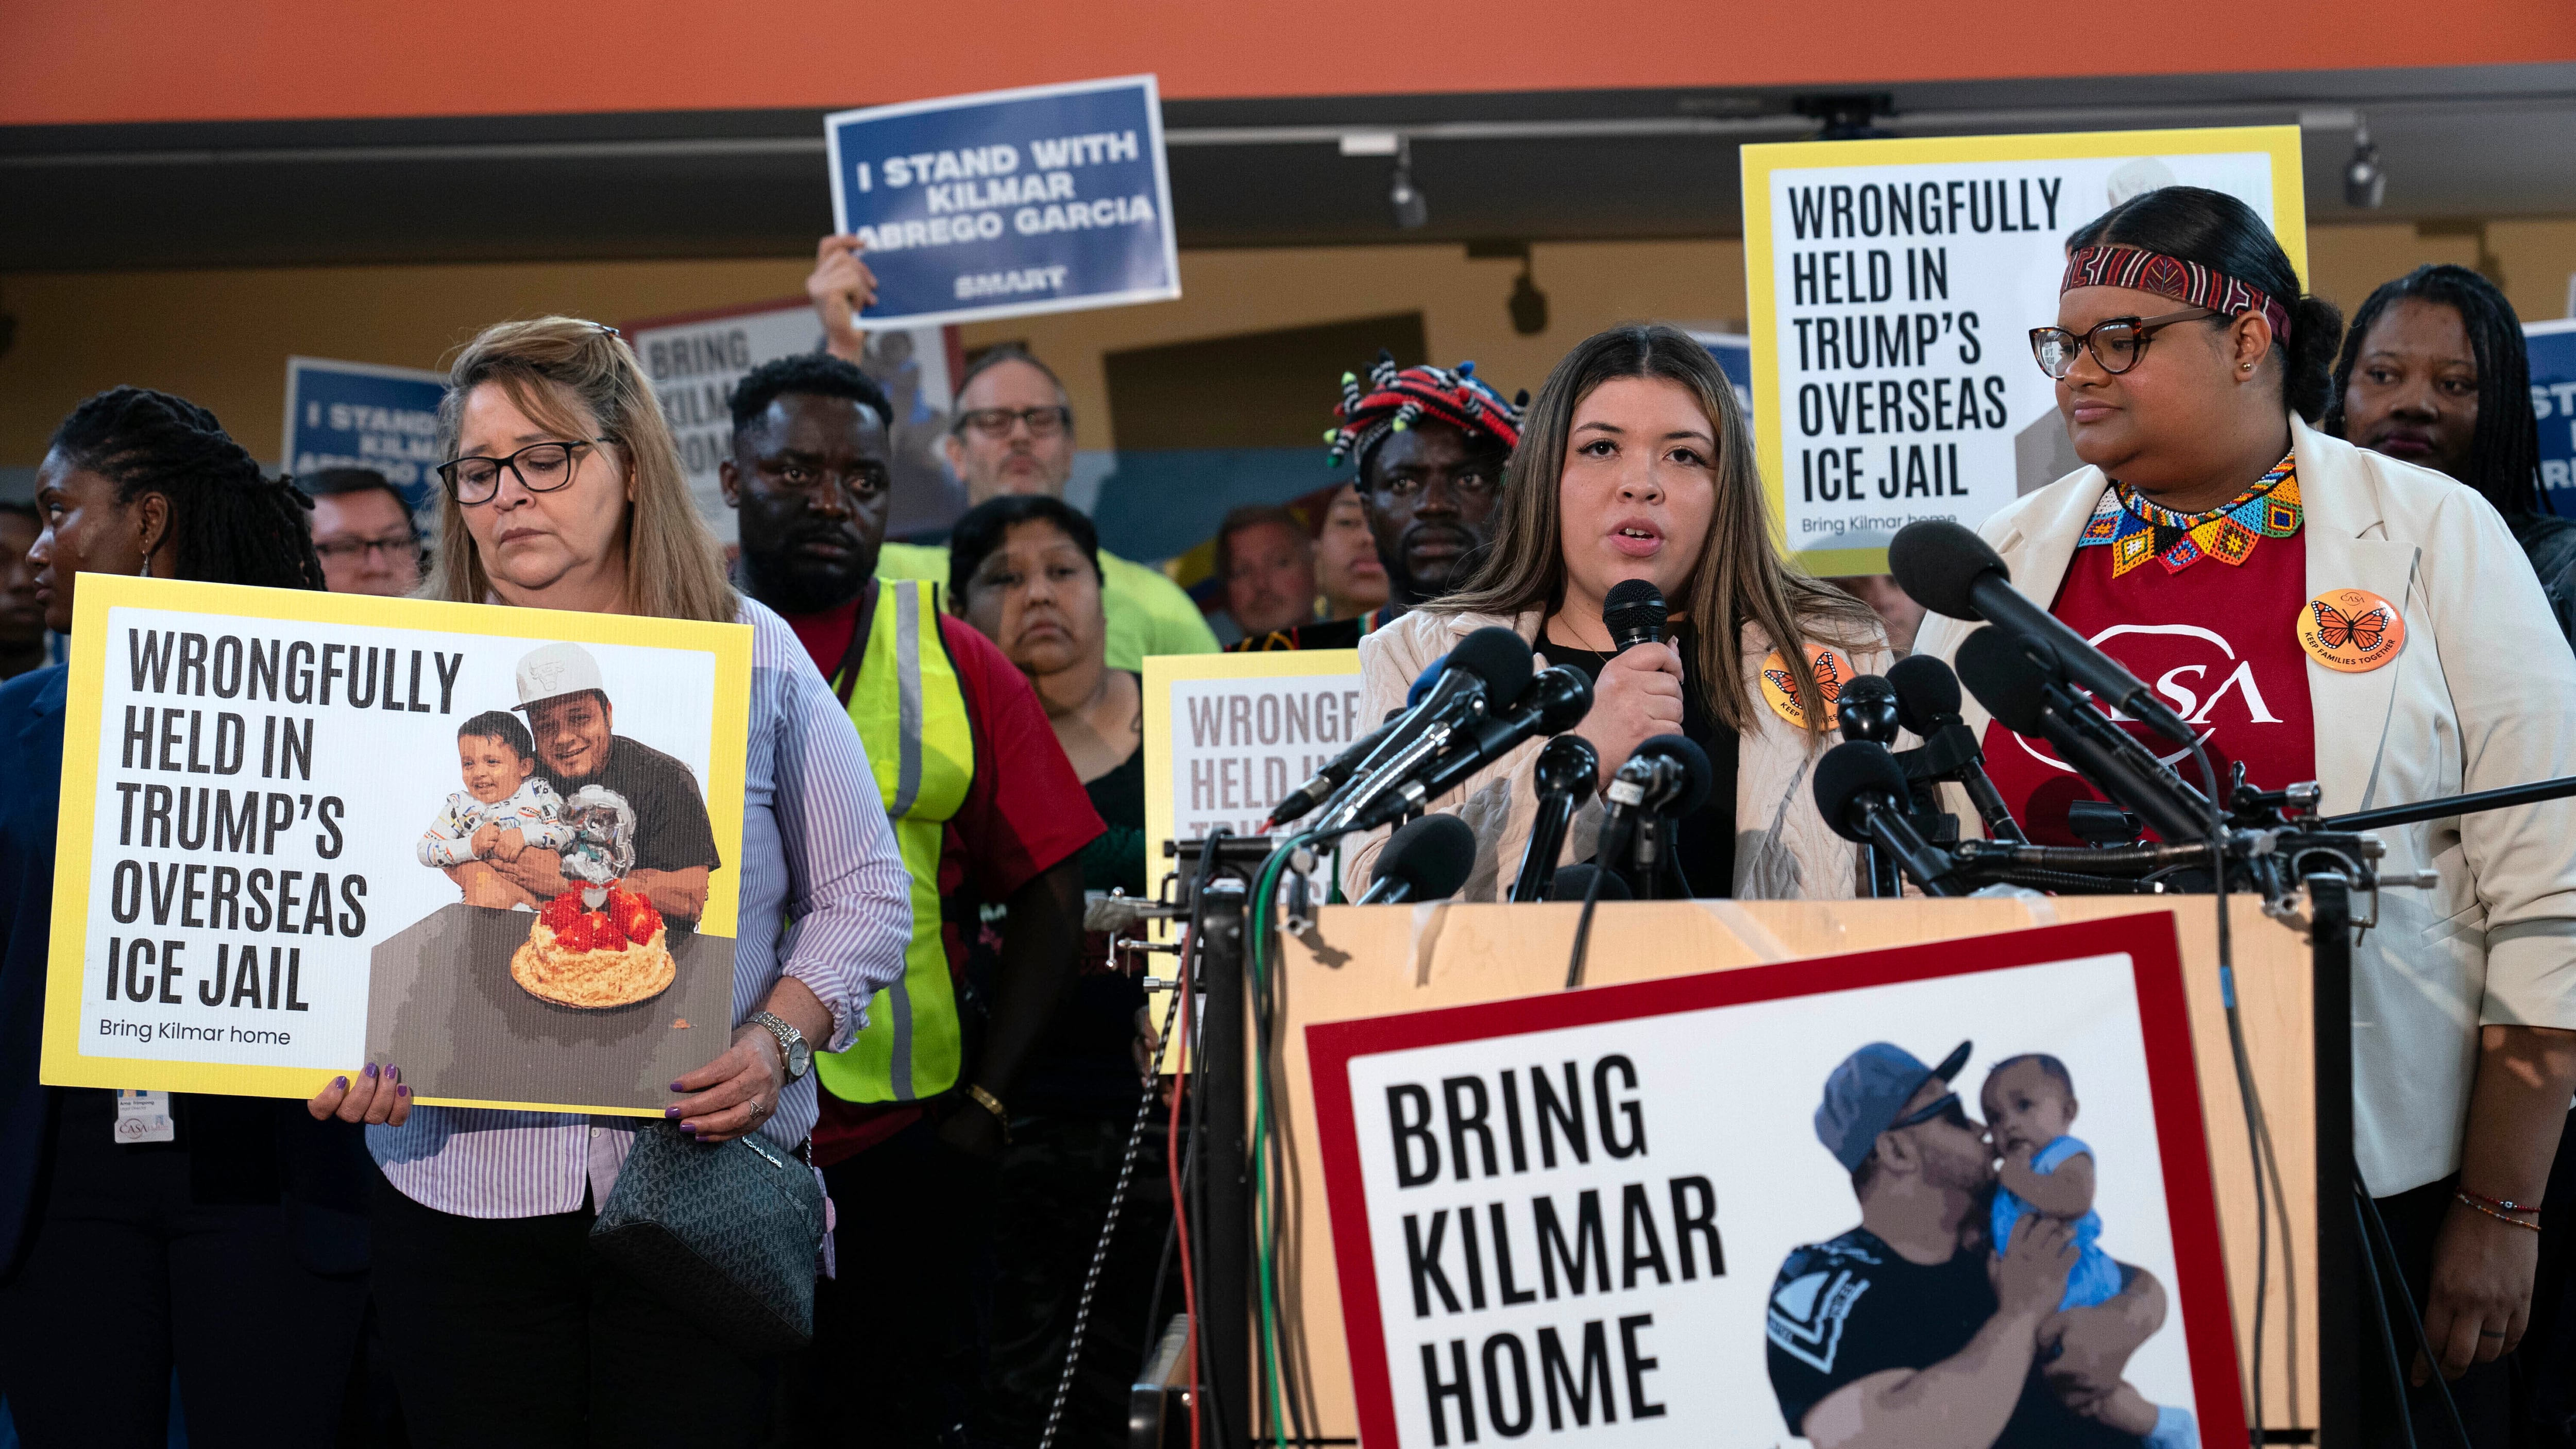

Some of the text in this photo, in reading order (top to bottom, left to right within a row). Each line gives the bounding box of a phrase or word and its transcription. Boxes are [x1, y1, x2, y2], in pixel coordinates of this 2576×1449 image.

[857, 130, 1139, 192] I STAND WITH
[926, 171, 1075, 215] KILMAR
[1788, 178, 2061, 240] WRONGFULLY
[856, 194, 1156, 252] ABREGO GARCIA
[955, 265, 1067, 298] SMART
[1793, 247, 1948, 306] HELD IN
[650, 328, 750, 381] BRING
[1793, 311, 1981, 371] TRUMP'S
[1799, 375, 2007, 437] OVERSEAS
[1802, 443, 1969, 503] ICE JAIL
[1802, 517, 1845, 535] Bring
[1850, 515, 1903, 531] Kilmar
[2341, 594, 2365, 603] CASA
[129, 628, 463, 714] WRONGFULLY
[2304, 632, 2396, 664] KEEP FAMILIES TOGETHER
[1188, 691, 1360, 747] WRONGF
[1780, 702, 1800, 717] KEEP
[122, 705, 314, 781] HELD IN
[1191, 756, 1287, 810] HELD
[116, 782, 344, 860] TRUMP'S
[111, 860, 367, 938] OVERSEAS
[106, 937, 309, 1012] ICE JAIL
[99, 1019, 291, 1045] Bring Kilmar home
[1386, 1054, 1648, 1189] BRING
[741, 1136, 783, 1168] MICHAEL KORS
[1402, 1175, 1726, 1319] KILMAR
[1420, 1314, 1667, 1448] HOME
